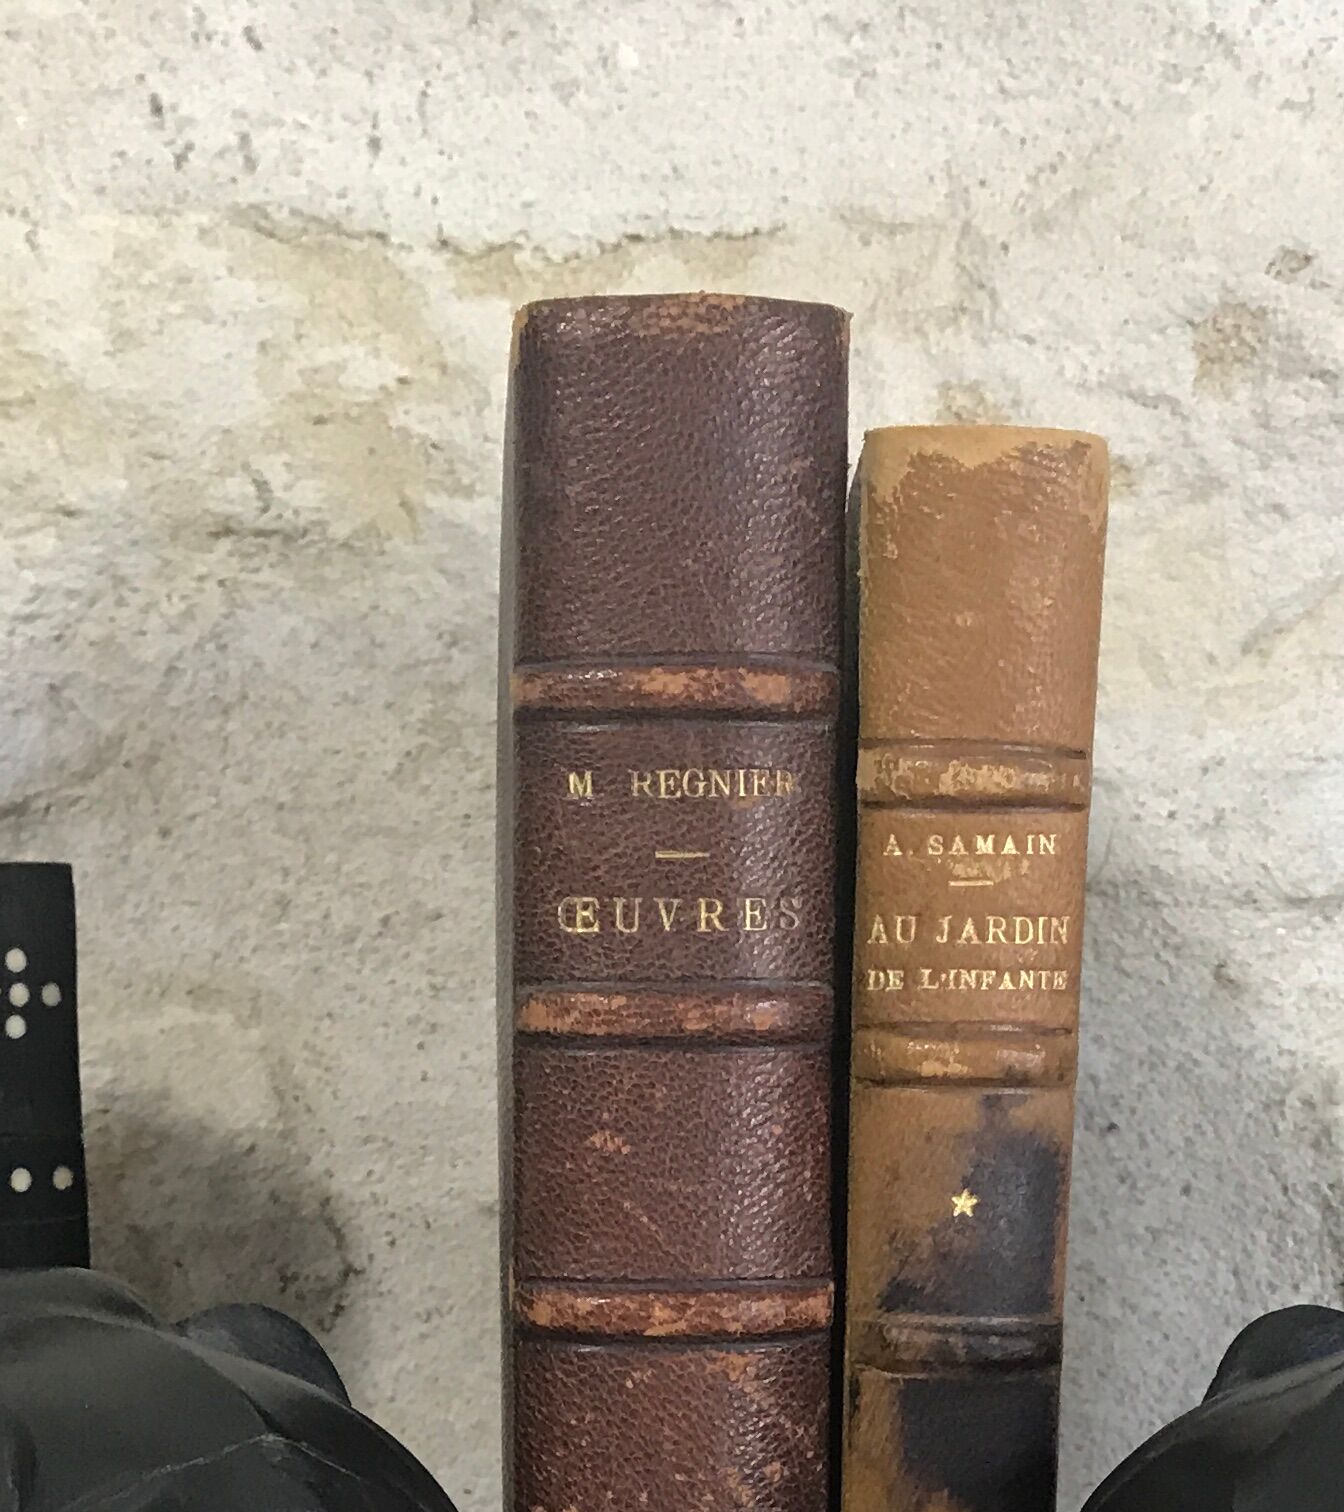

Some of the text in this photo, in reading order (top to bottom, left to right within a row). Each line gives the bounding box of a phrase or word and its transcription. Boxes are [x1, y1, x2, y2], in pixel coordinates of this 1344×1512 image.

[628, 768, 799, 798] REGNIER
[927, 834, 1057, 855] SAMAIN
[557, 896, 803, 933] ŒUVRES
[866, 914, 1071, 945] AU JARDIN
[866, 968, 1068, 992] DE L'INFANTE
